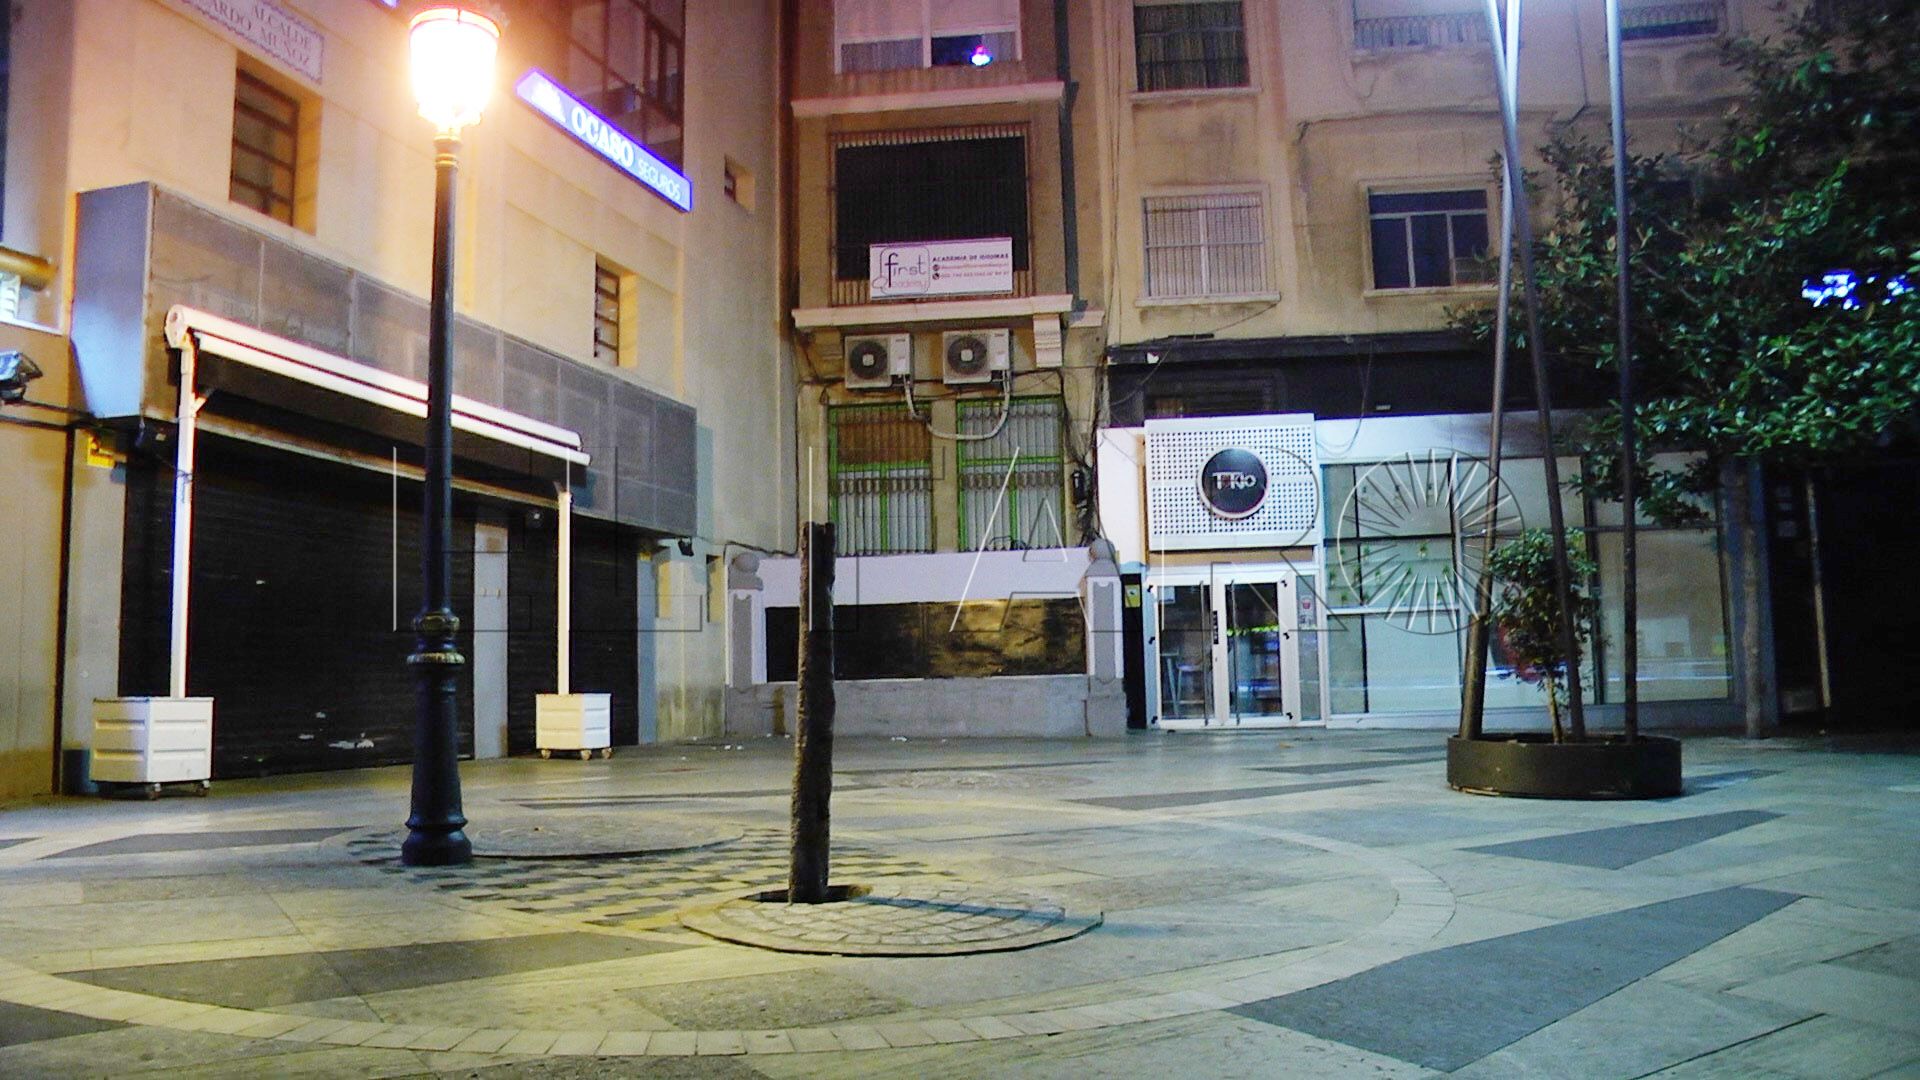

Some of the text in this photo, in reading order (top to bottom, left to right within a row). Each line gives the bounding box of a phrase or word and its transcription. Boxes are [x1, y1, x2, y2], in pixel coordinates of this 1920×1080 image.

[212, 0, 252, 31] ARDO
[253, 5, 311, 49] ALCALDE
[571, 106, 682, 201] OCASO SEGUROS
[884, 252, 927, 288] first
